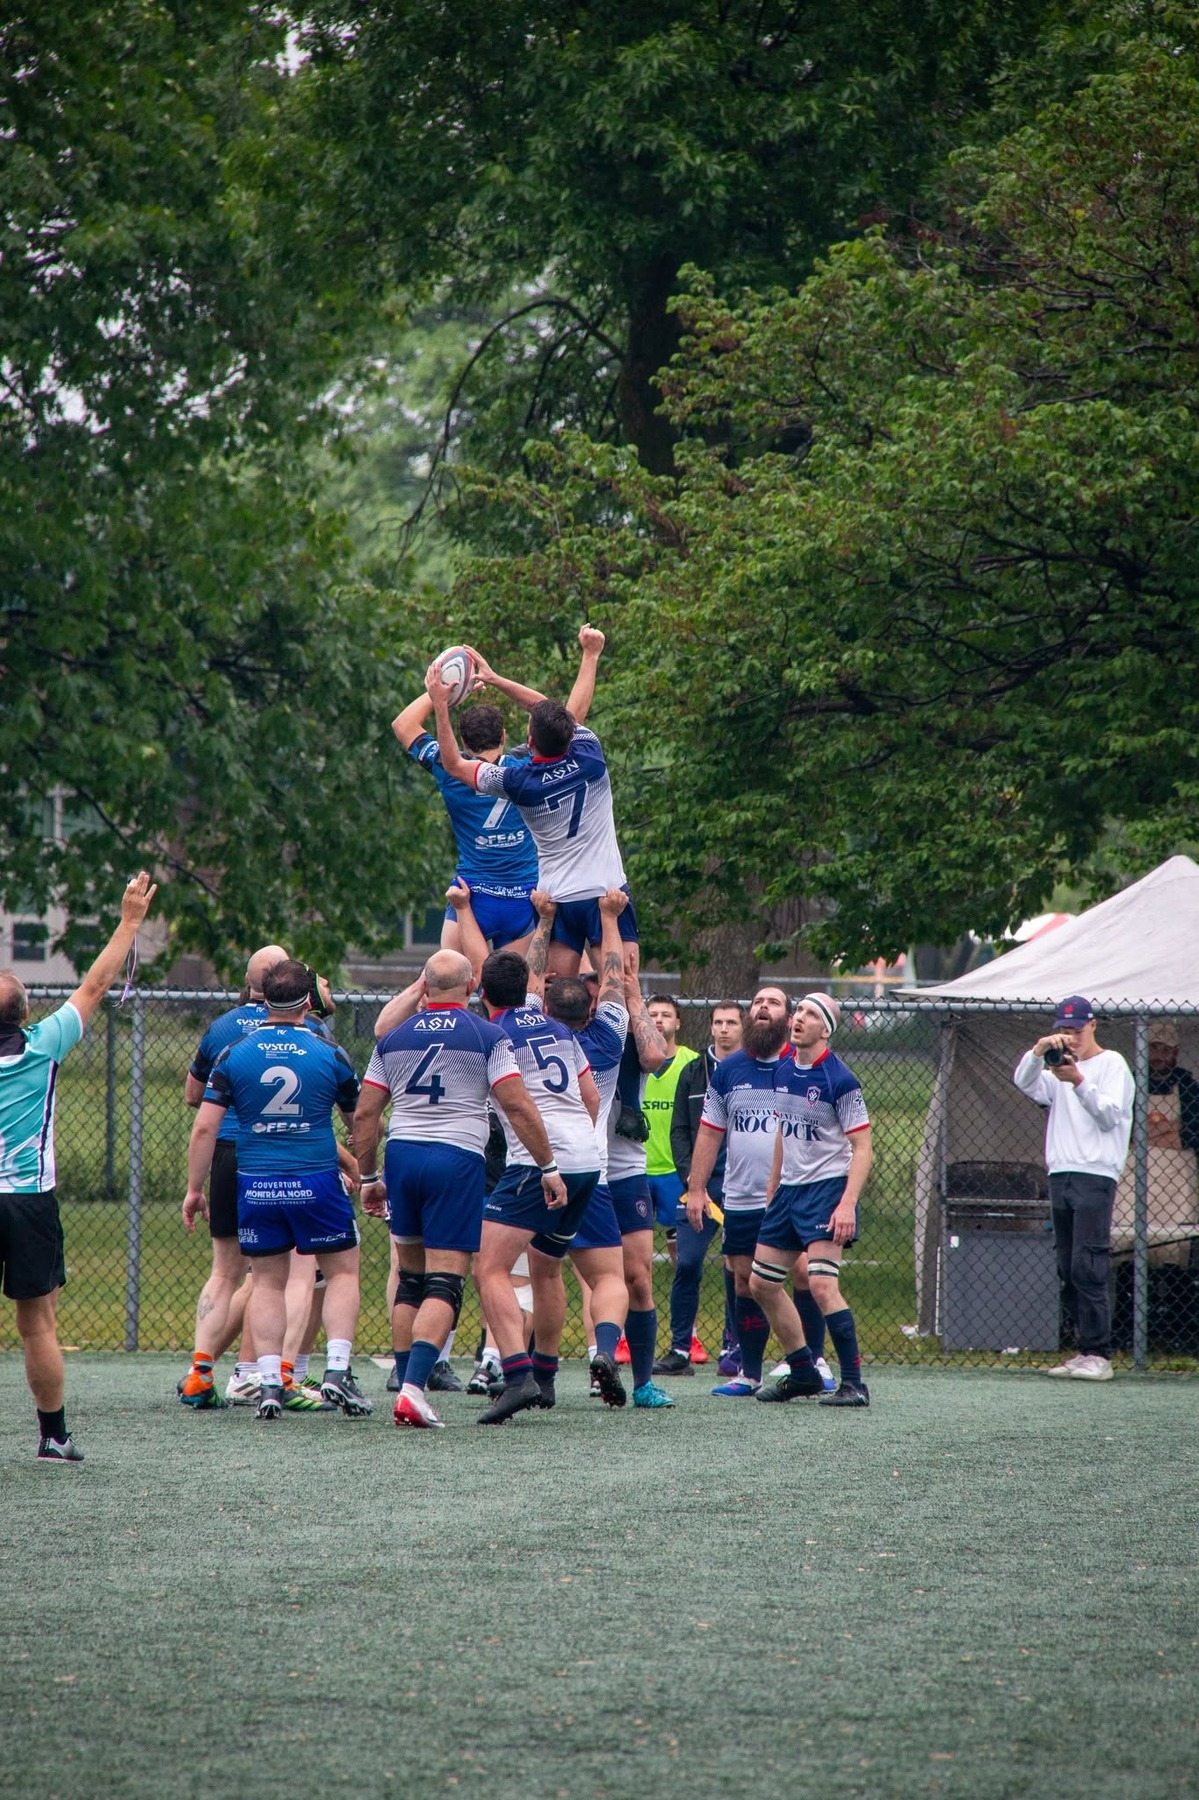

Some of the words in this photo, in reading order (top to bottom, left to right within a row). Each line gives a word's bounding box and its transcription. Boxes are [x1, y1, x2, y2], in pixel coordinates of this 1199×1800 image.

[541, 759, 580, 783] ASN
[475, 791, 512, 831] 7
[544, 780, 589, 839] 7
[487, 830, 526, 845] FEAS
[413, 1017, 457, 1031] ASN
[257, 1043, 298, 1051] SYSTRA
[404, 1043, 447, 1105] 4
[526, 1034, 570, 1095] 5
[259, 1065, 304, 1118] 2
[266, 1122, 311, 1134] FEAS
[252, 1180, 302, 1189] COUVERTURE
